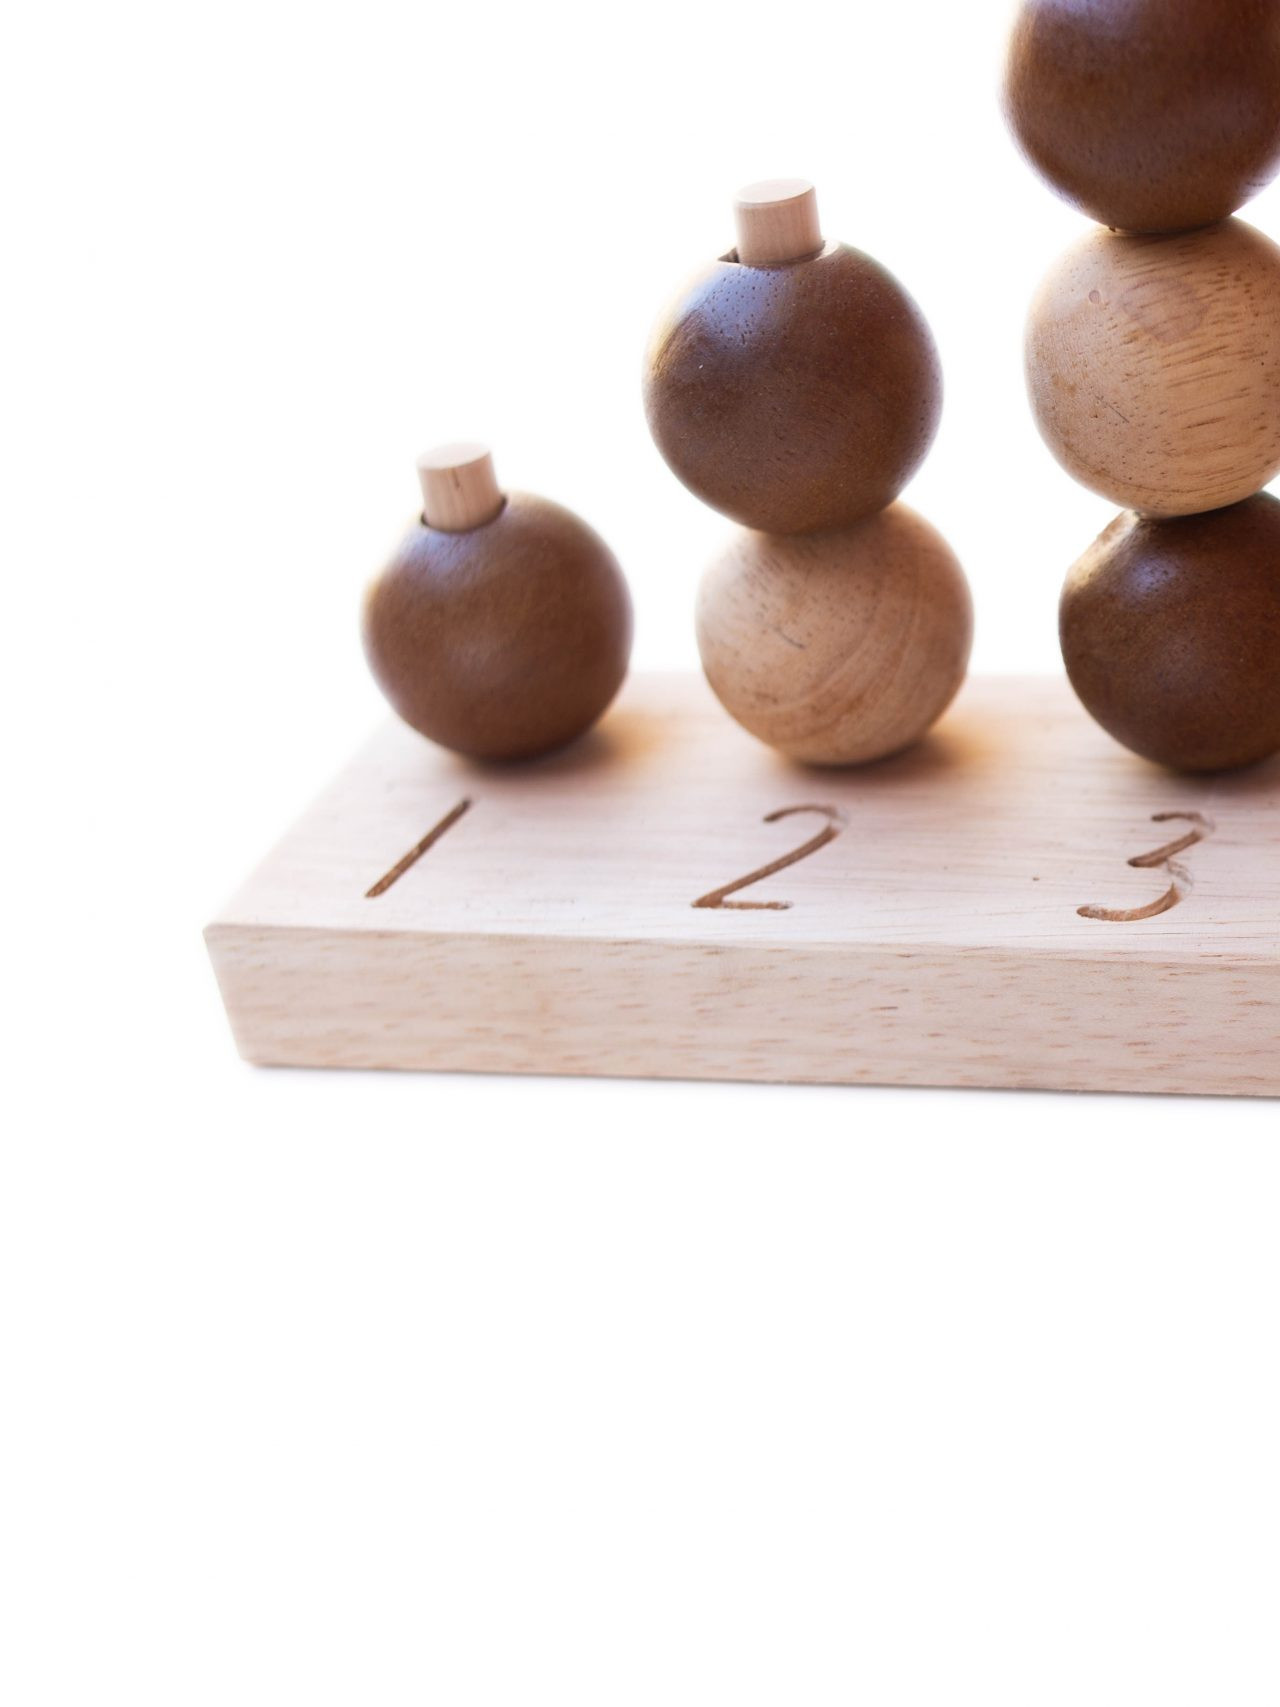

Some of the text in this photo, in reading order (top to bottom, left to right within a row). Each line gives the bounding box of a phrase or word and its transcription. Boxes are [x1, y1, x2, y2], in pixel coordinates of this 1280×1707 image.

[365, 796, 475, 899] 1
[690, 804, 848, 911] 2
[1076, 811, 1216, 922] 3
